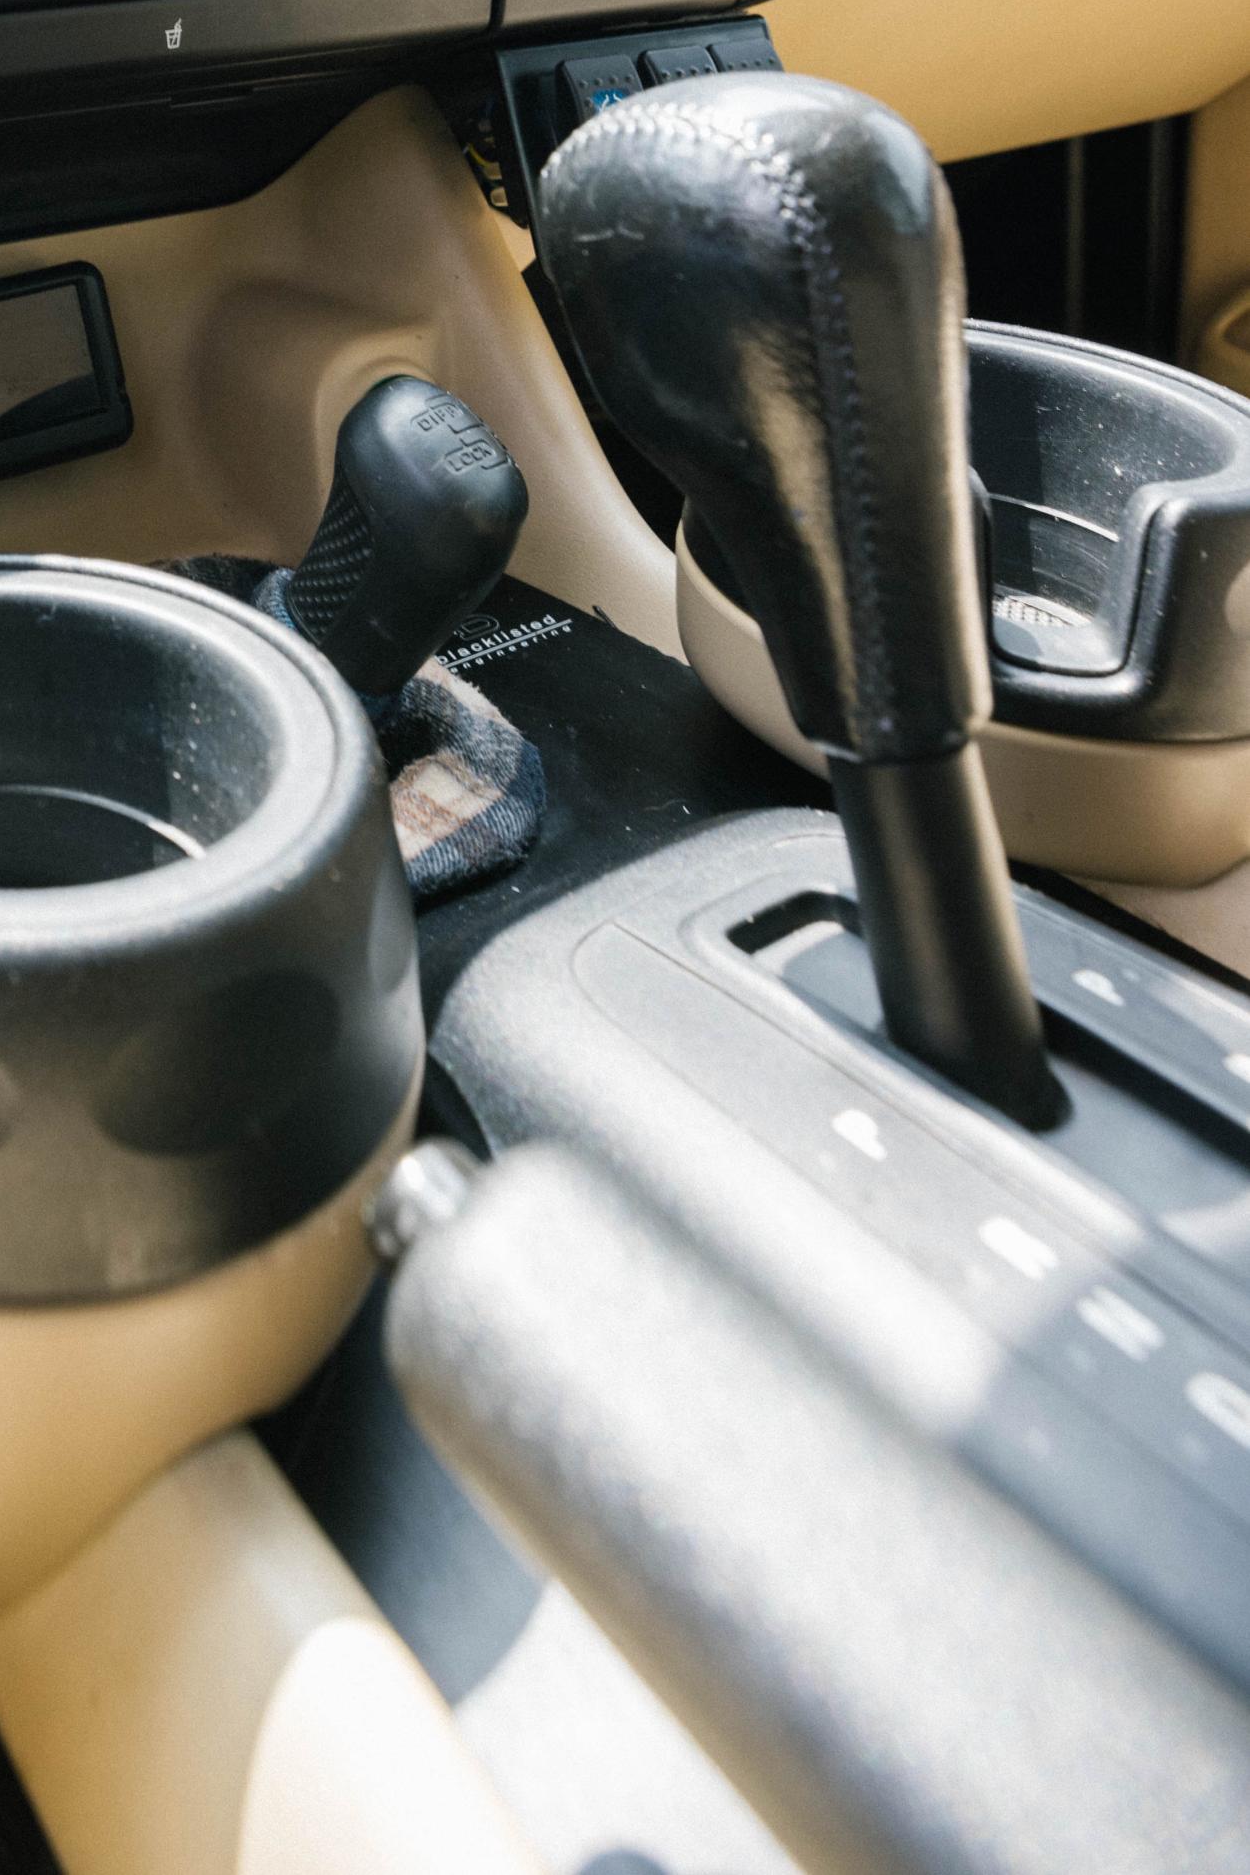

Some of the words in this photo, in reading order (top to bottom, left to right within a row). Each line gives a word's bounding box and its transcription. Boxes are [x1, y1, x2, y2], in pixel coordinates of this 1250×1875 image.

[447, 446, 493, 472] LOCK
[434, 613, 557, 666] blacklisted
[449, 624, 572, 675] engineering
